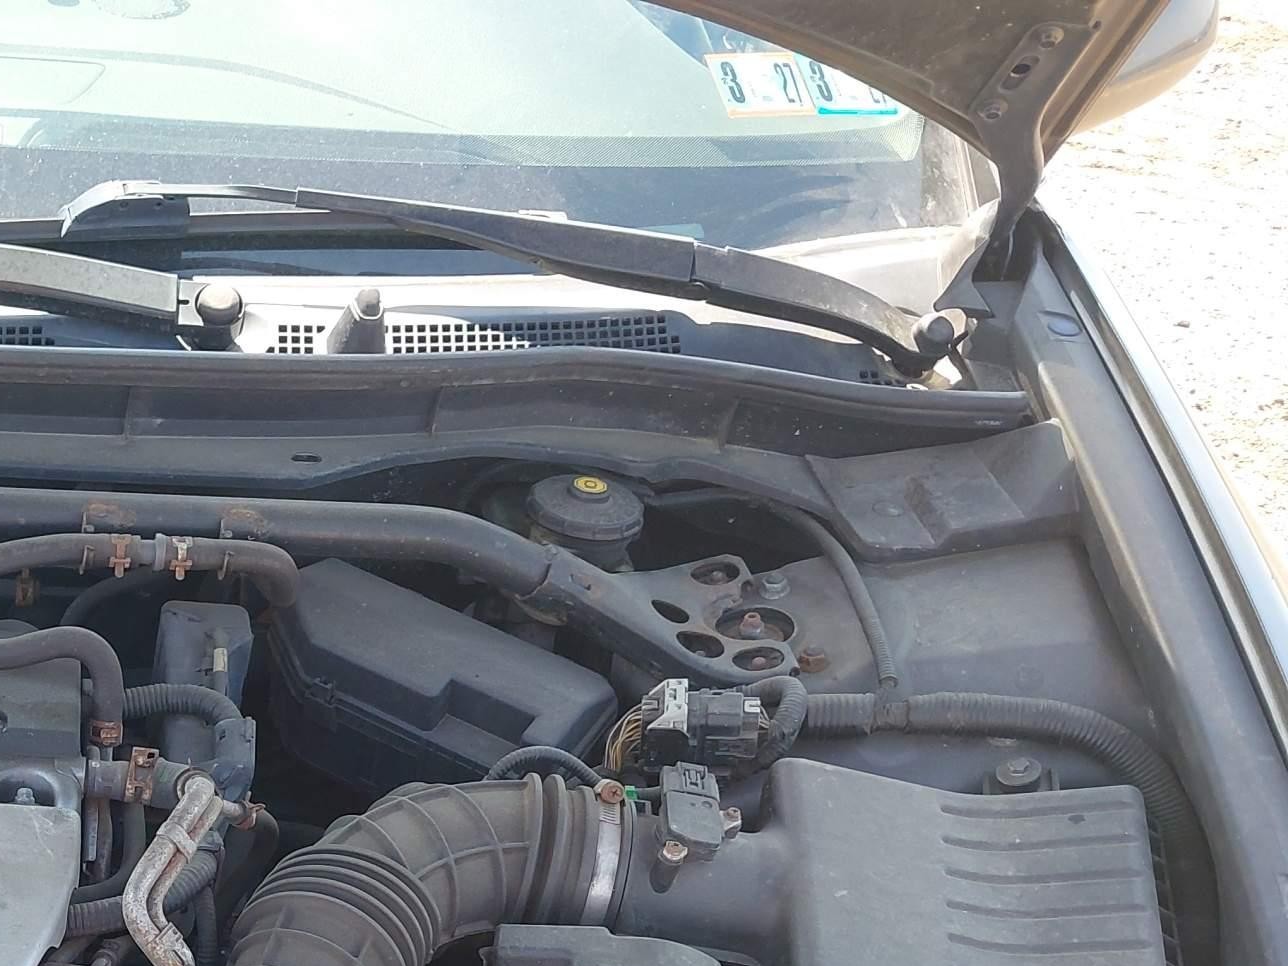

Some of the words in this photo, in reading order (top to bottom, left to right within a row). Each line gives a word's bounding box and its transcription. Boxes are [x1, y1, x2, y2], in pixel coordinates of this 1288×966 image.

[720, 61, 746, 104] 3
[773, 62, 804, 106] 27
[809, 61, 833, 102] 3
